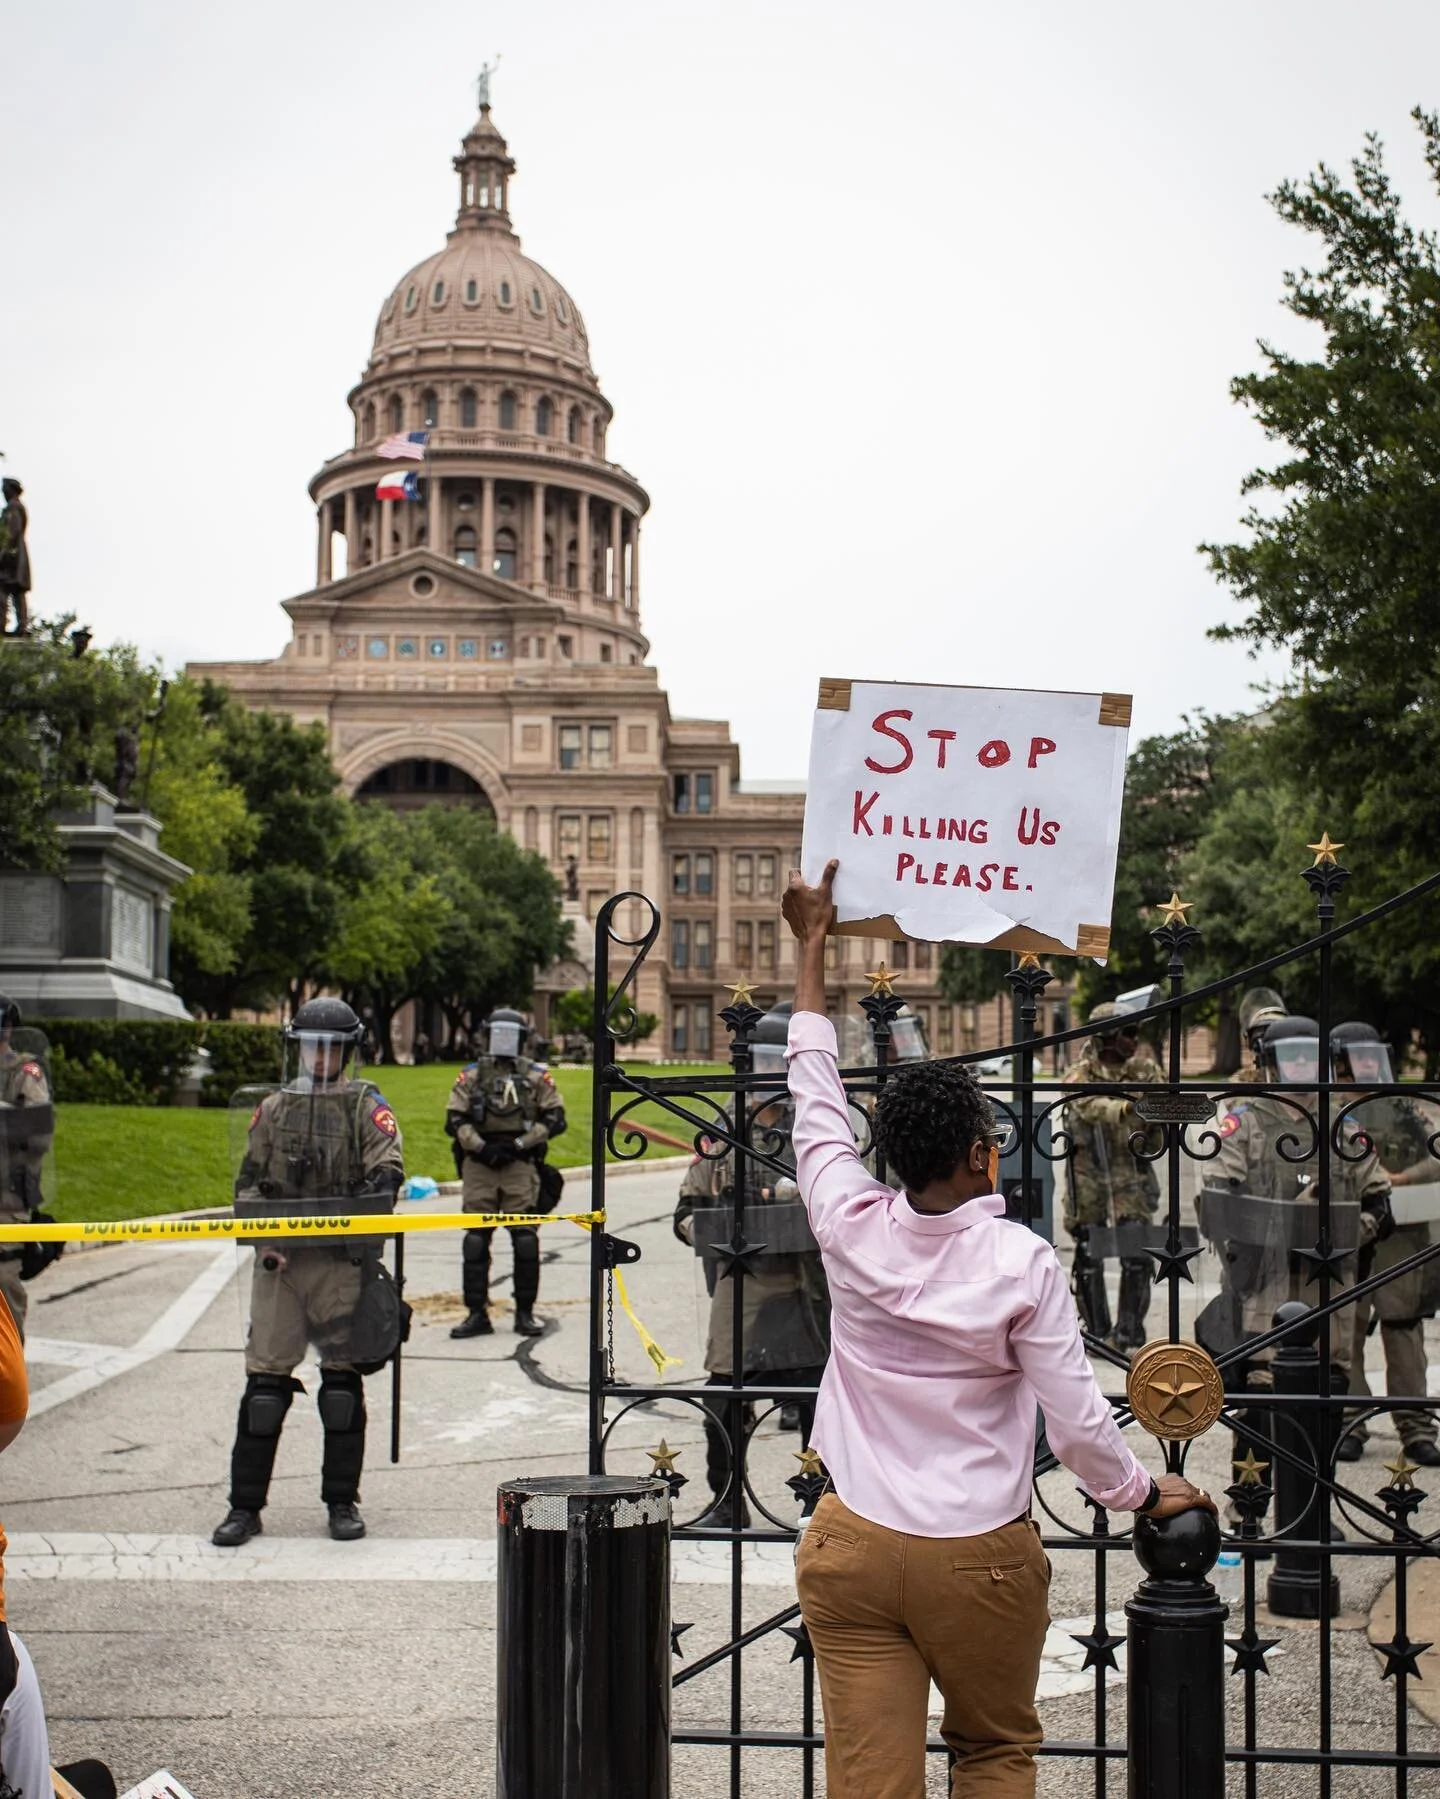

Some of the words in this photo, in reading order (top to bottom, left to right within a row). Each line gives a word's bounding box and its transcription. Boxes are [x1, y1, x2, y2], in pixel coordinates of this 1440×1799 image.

[864, 709, 1057, 775] STOP
[853, 790, 988, 844] KILLING
[1017, 806, 1061, 846] US
[896, 852, 1034, 893] PLEASE.
